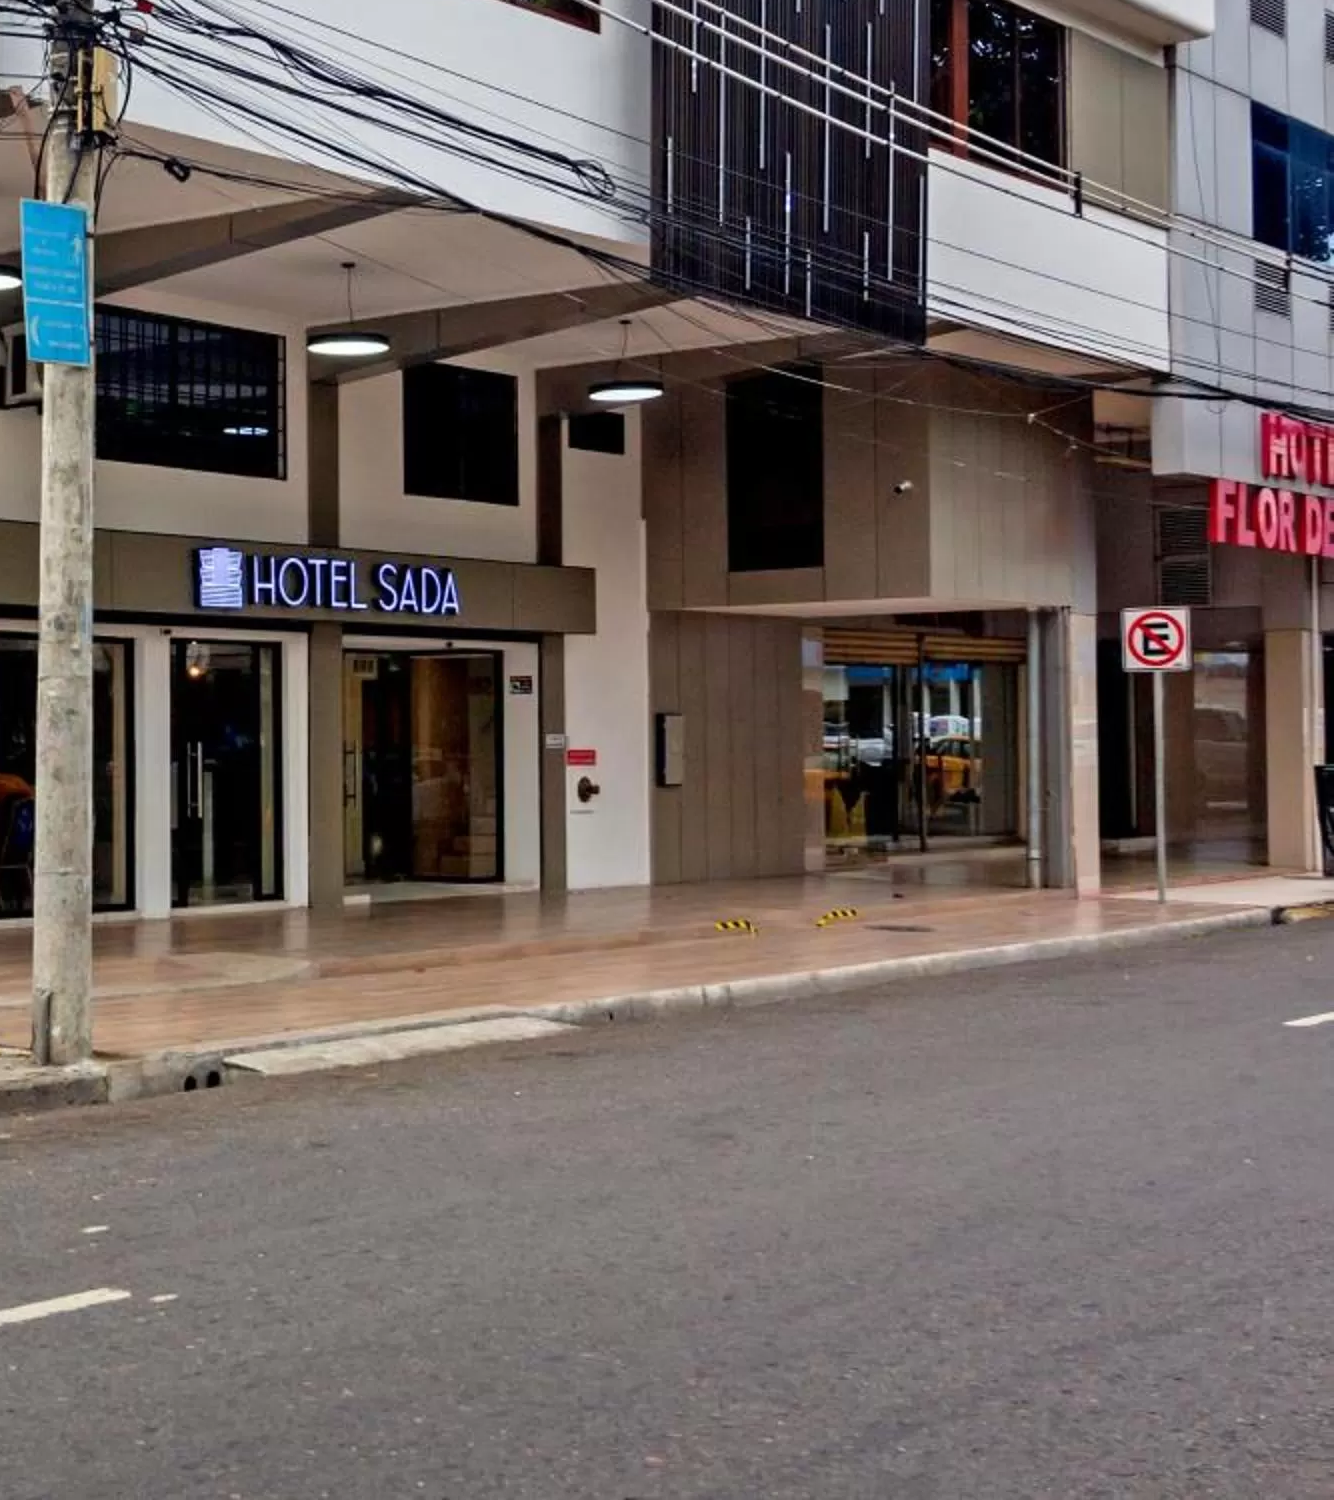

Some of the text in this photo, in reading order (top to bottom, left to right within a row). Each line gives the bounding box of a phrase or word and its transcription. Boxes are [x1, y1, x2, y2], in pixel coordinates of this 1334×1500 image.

[1213, 479, 1298, 553] FLOR
[252, 555, 460, 615] HOTEL SADA
[1141, 621, 1171, 656] E
